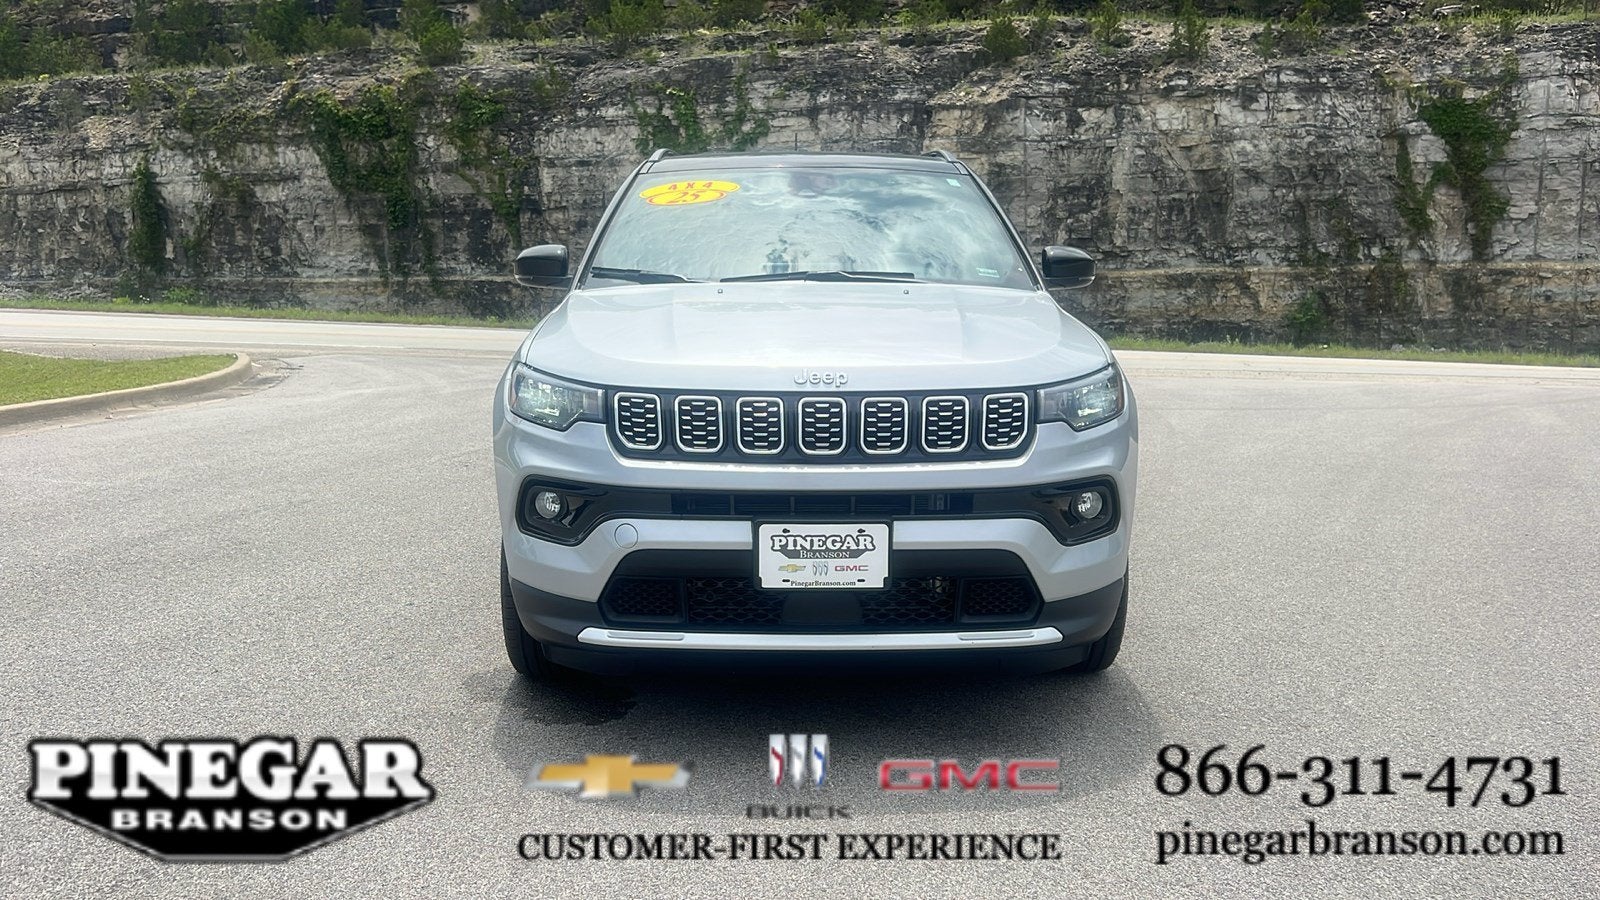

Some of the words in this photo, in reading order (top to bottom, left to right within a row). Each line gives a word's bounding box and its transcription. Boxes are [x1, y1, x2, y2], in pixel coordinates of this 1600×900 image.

[793, 368, 849, 388] Jeep
[771, 535, 876, 551] PINEGAR
[800, 550, 851, 559] BRANSON
[790, 580, 857, 588] PinegarBranson.com
